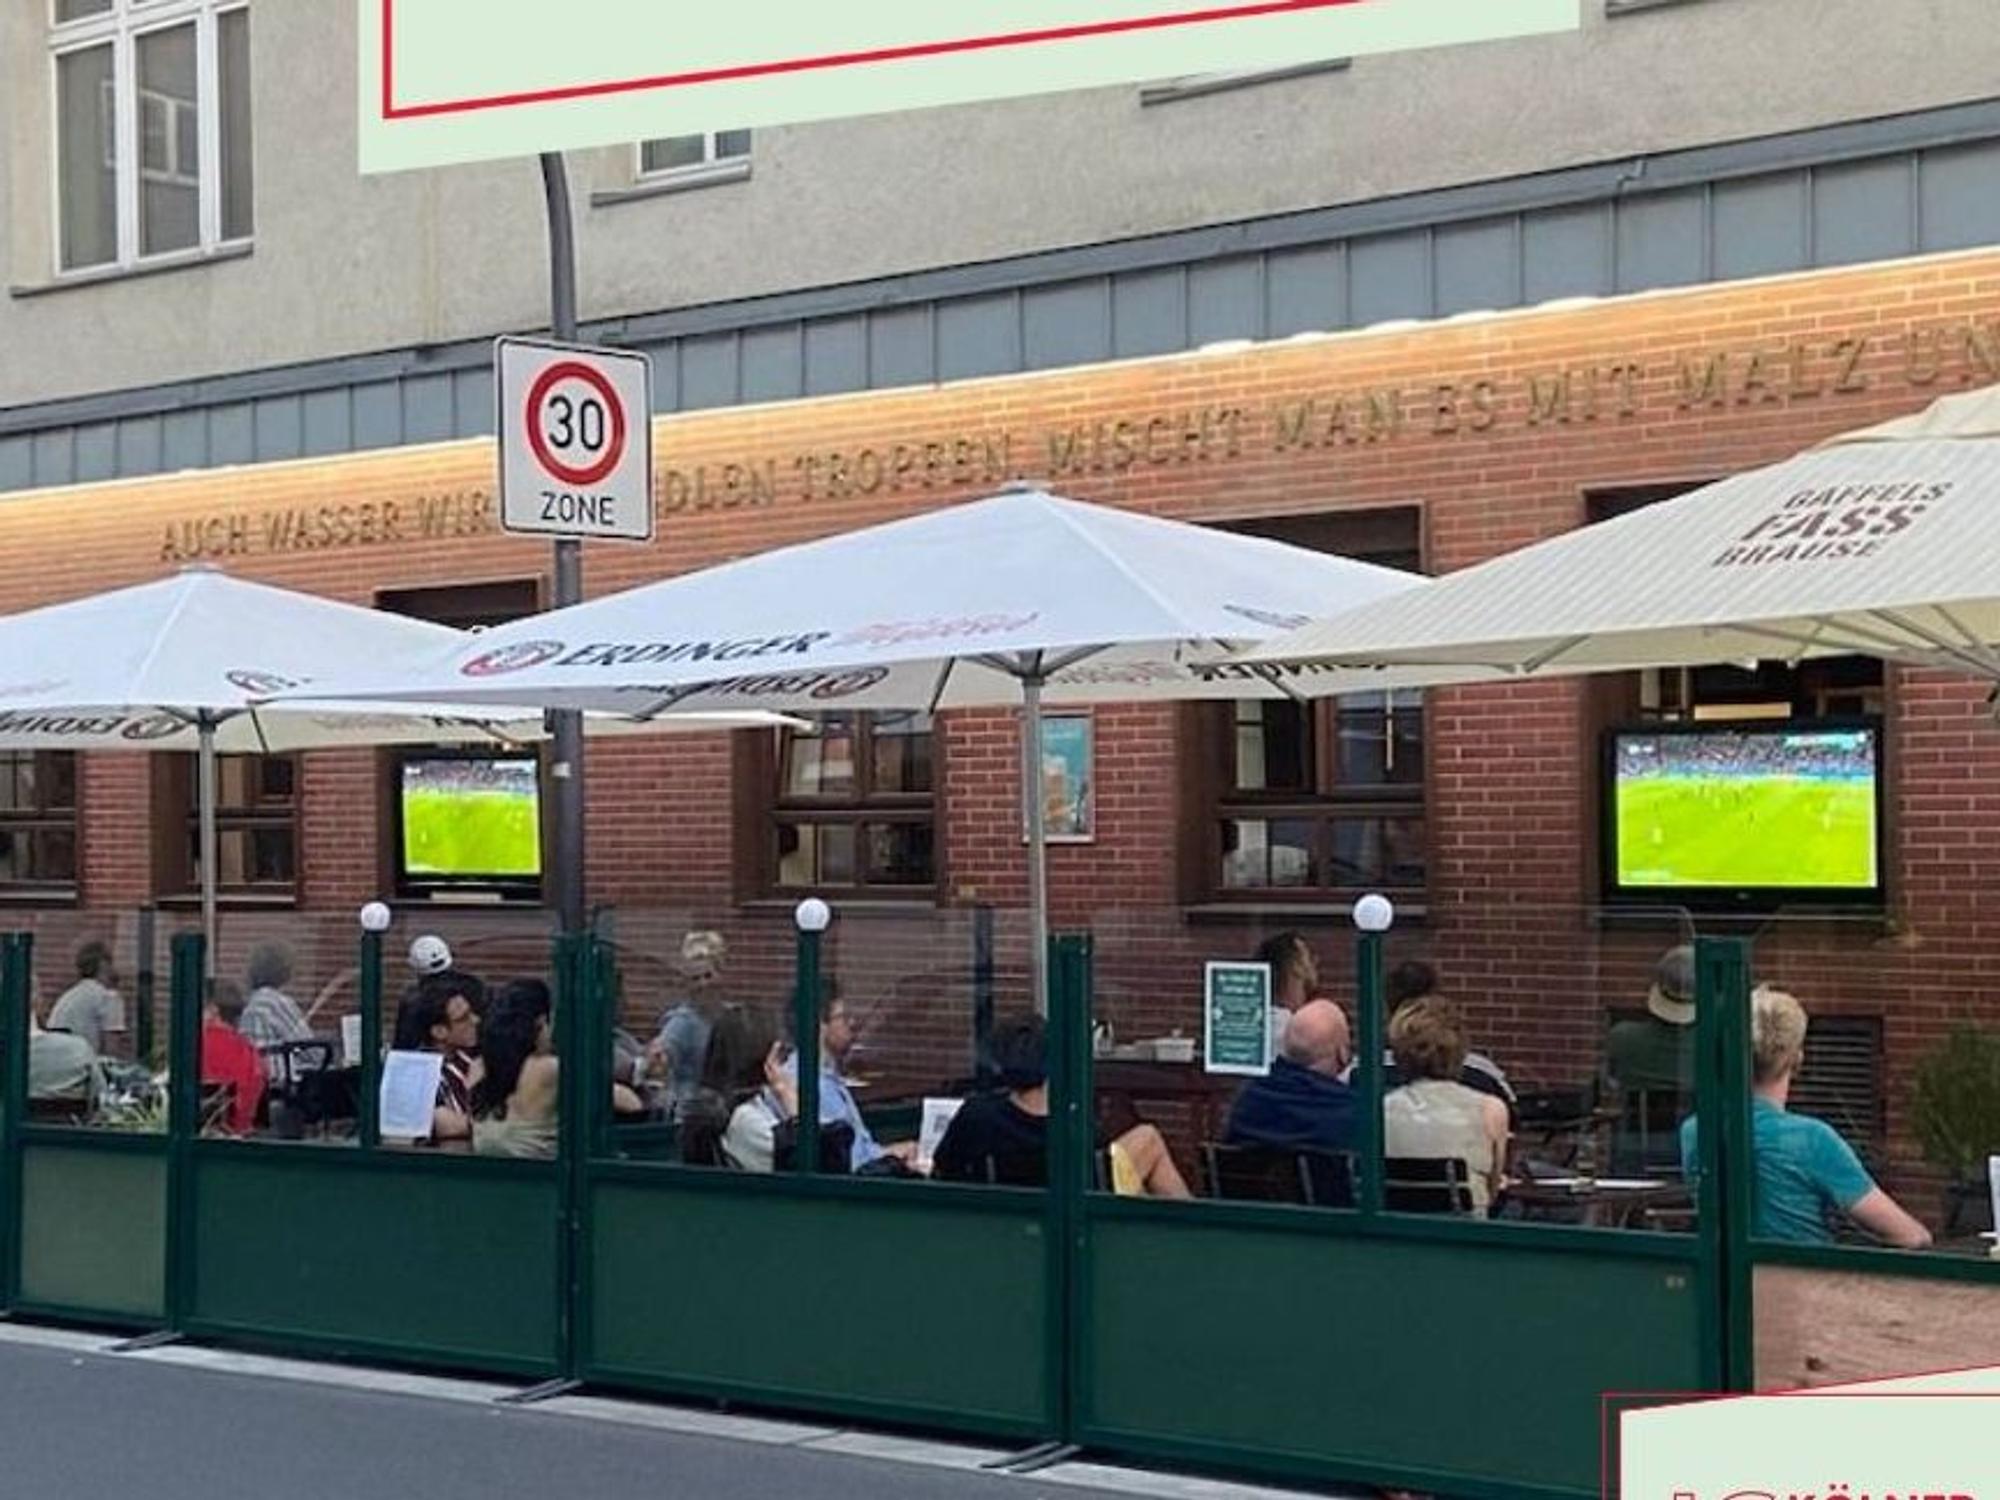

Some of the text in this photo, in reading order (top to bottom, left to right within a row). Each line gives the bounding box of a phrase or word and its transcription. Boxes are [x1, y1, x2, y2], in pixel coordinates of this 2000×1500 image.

[548, 395, 605, 451] 30
[160, 514, 249, 560] AUCH
[262, 500, 403, 550] WASSER
[418, 490, 496, 535] WIR
[662, 459, 776, 513] DLEN
[1047, 406, 1247, 476] MISCHT
[1273, 388, 1401, 452] MAN
[1431, 380, 1497, 435] ES
[1526, 361, 1644, 427] MIT
[1675, 338, 1867, 411] MALZ
[540, 491, 616, 526] ZONE
[1783, 481, 1953, 509] GAFFELS
[1741, 504, 1927, 541] FASS
[1712, 539, 1890, 567] BRAUSE
[554, 631, 832, 667] ERDINGER
